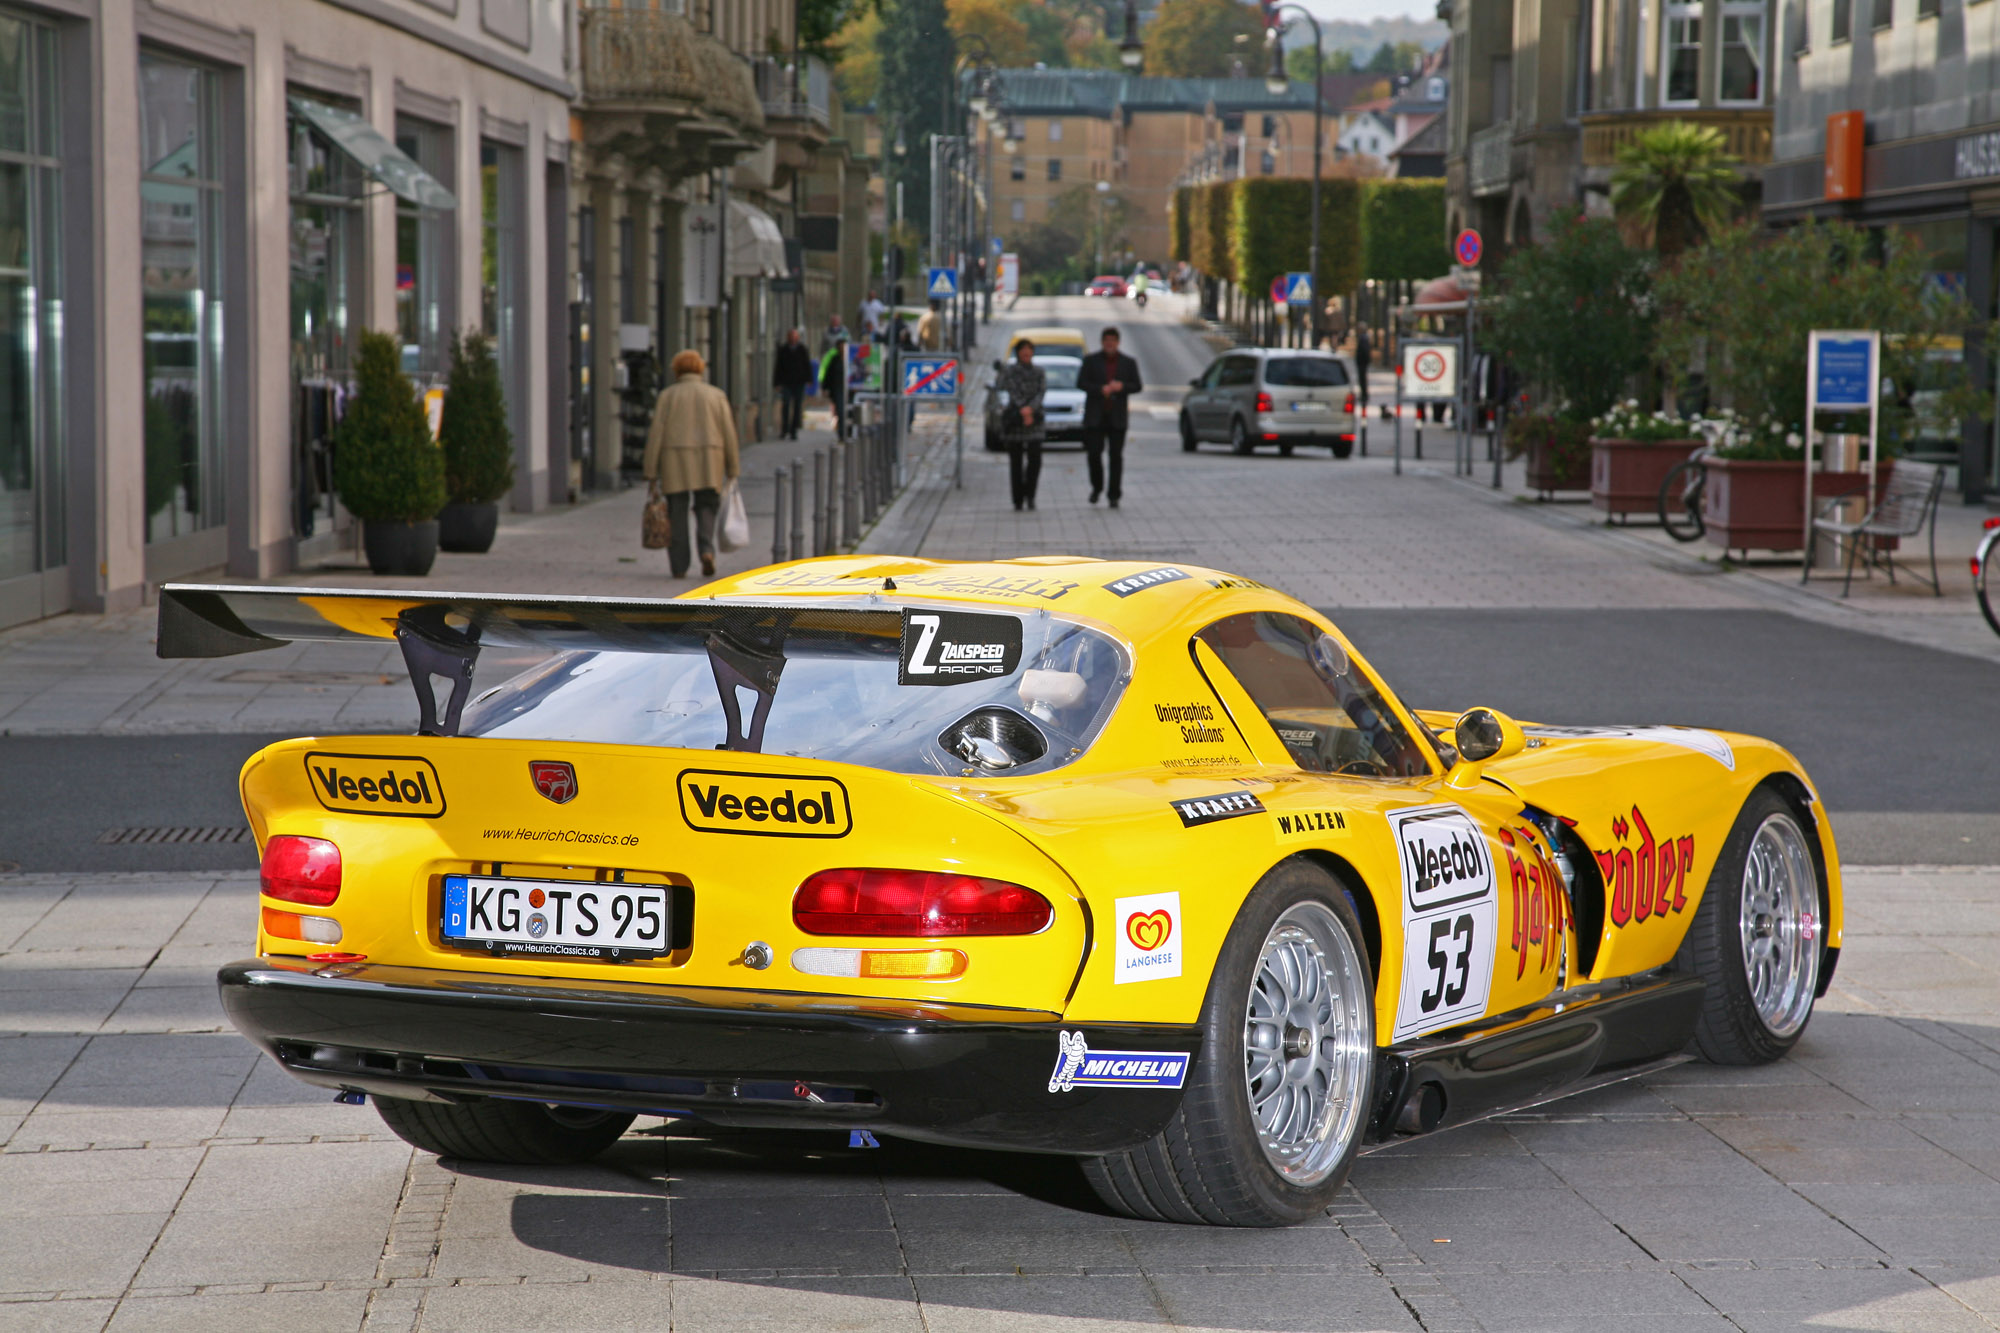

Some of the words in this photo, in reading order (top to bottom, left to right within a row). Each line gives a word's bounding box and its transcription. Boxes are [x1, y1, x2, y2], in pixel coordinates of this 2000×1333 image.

[1113, 569, 1184, 593] KRAFFT
[937, 586, 1021, 598] Soltau
[940, 642, 1005, 663] ZAKSPEED
[939, 665, 1004, 674] RACING
[1155, 701, 1214, 724] Unigraphics
[1160, 754, 1242, 768] www.zakspeed.de
[312, 765, 433, 804] Veedol
[687, 783, 836, 825] Veedol
[1181, 795, 1258, 819] KRAFFT
[1277, 811, 1346, 835] WALZEN
[482, 828, 640, 847] www.HeurichClassics.de
[1407, 828, 1484, 893] Veedol
[451, 913, 461, 927] D
[470, 886, 520, 932] KG
[549, 891, 599, 937] TS
[611, 895, 661, 941] 95
[505, 942, 601, 957] www.HeurichClassics.de
[1126, 953, 1173, 969] LANGNESE
[1420, 913, 1475, 1014] 53
[1082, 1059, 1183, 1078] MICHELIN
